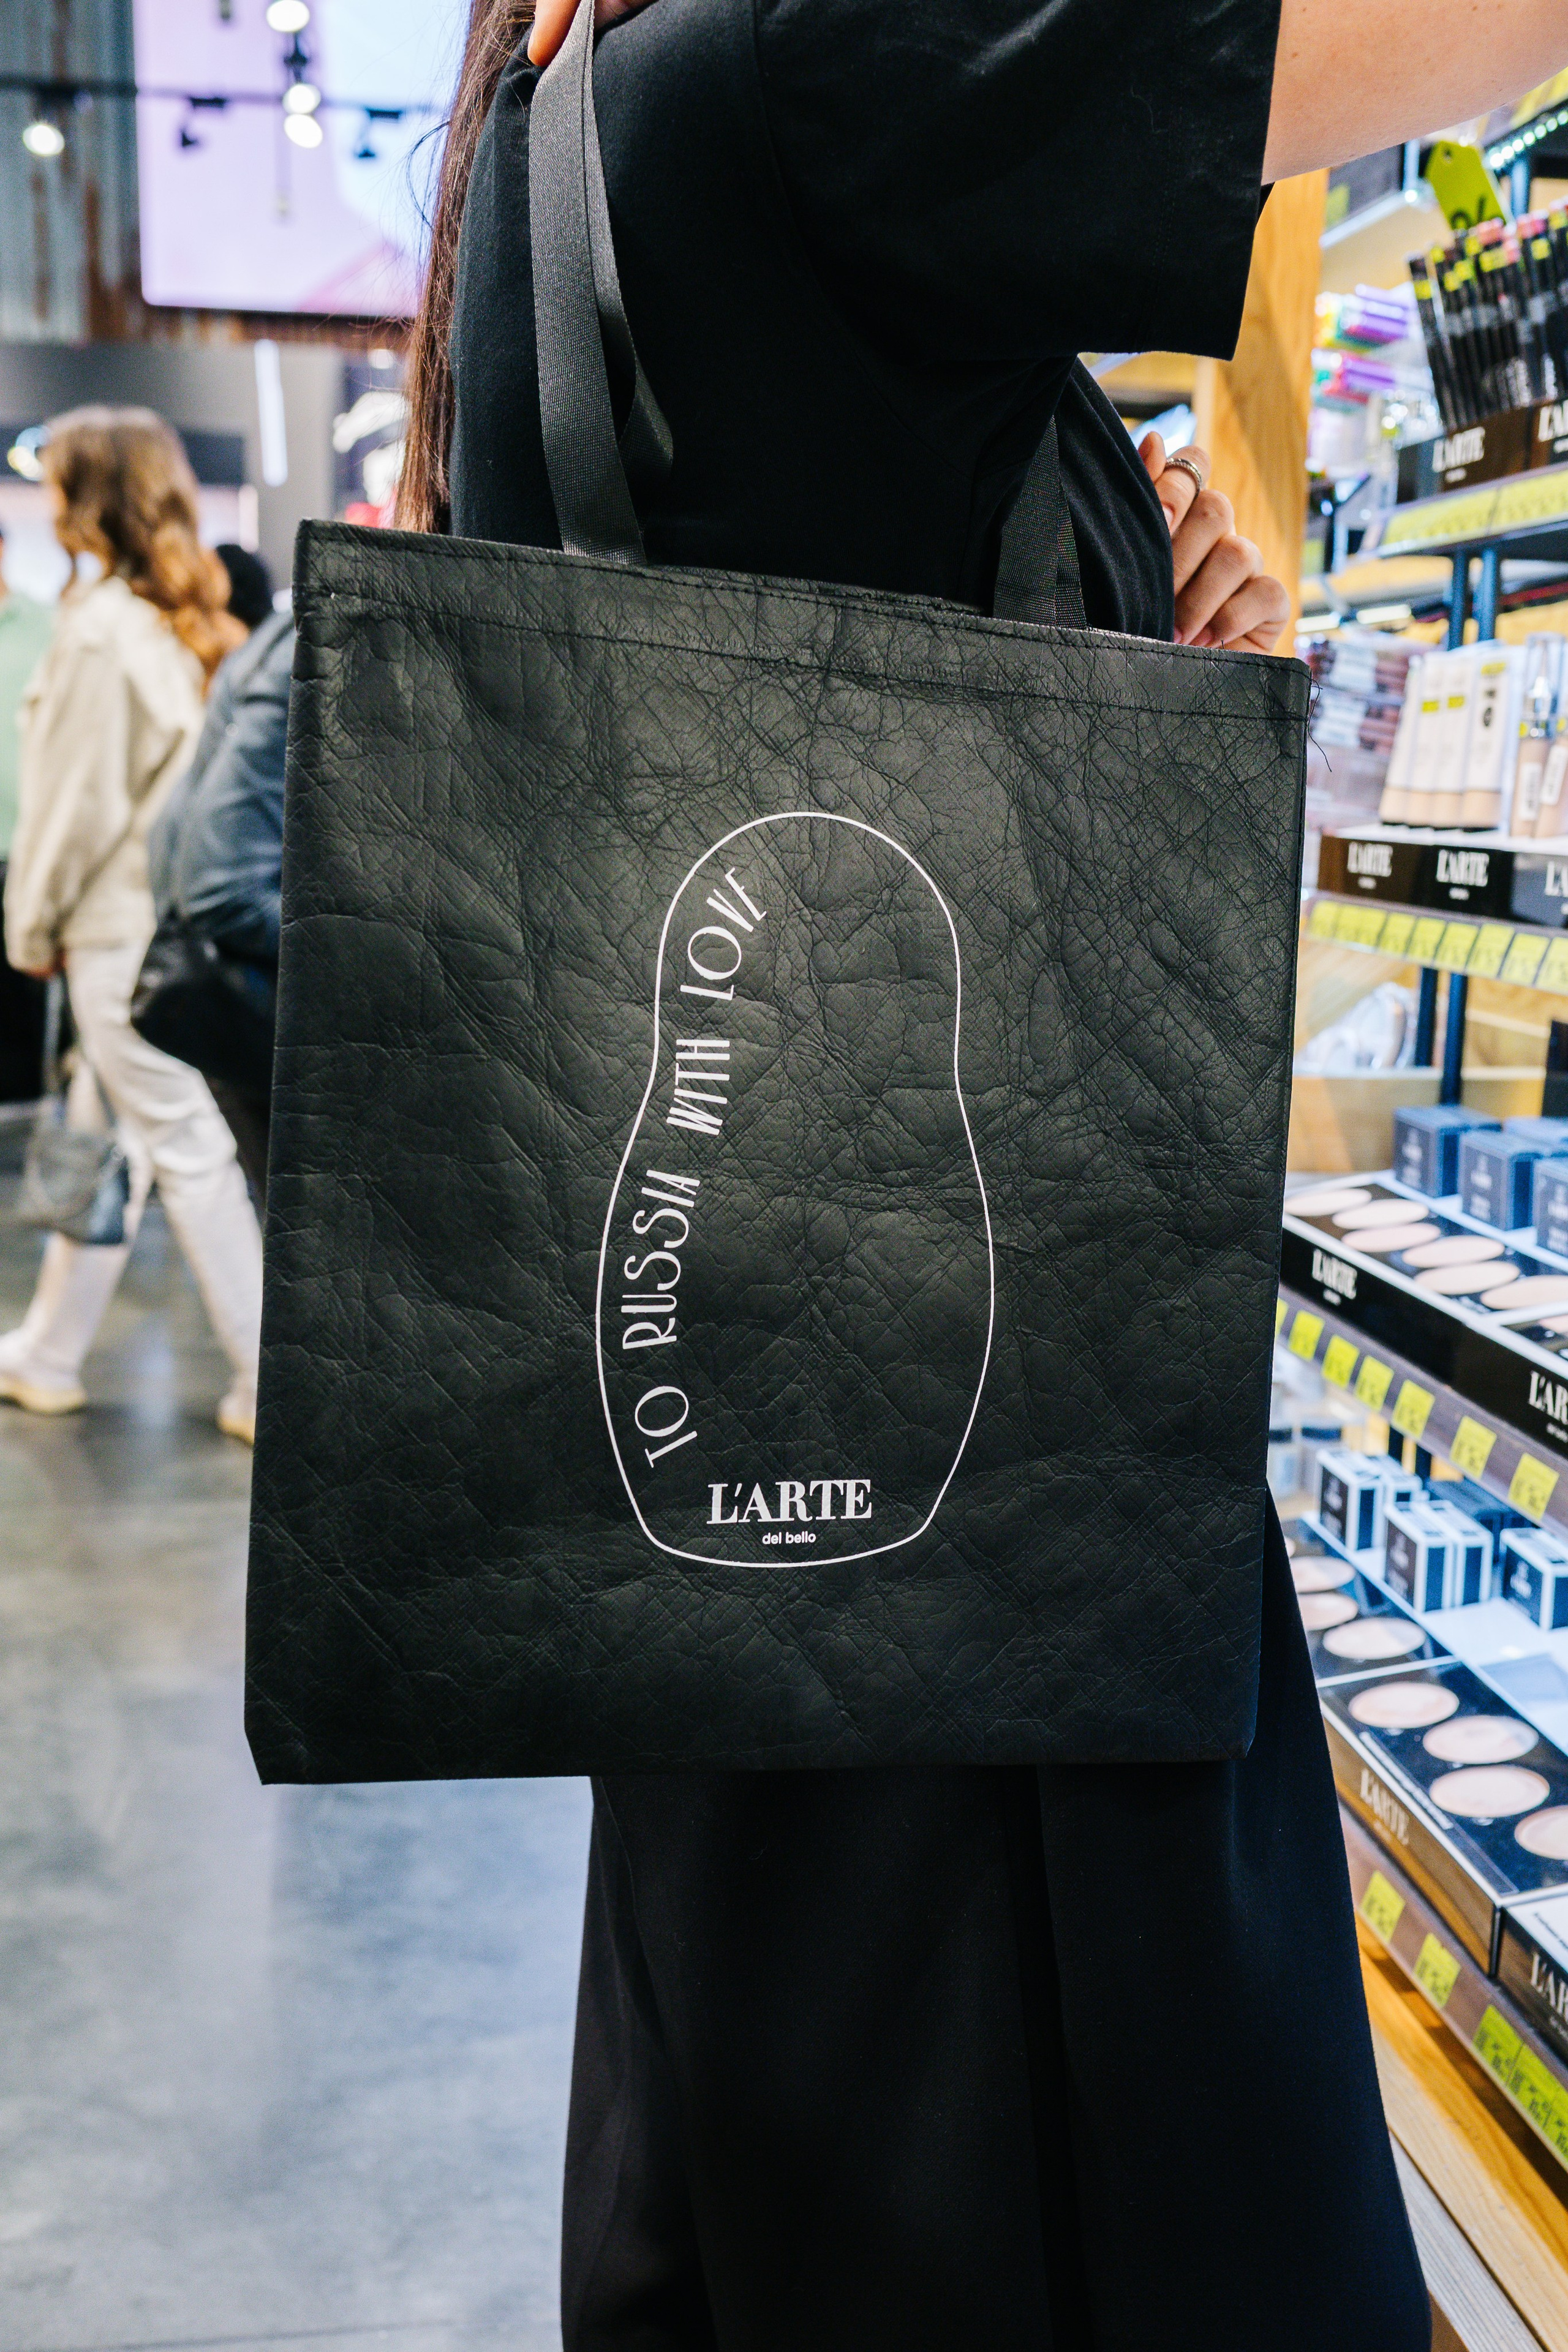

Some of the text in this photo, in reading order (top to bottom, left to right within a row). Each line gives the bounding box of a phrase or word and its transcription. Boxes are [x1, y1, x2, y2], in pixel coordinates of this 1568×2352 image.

[621, 867, 767, 1468] TO RUSSIA WITH LOVE
[706, 1479, 872, 1525] L'ARTE
[762, 1531, 816, 1545] del bello
